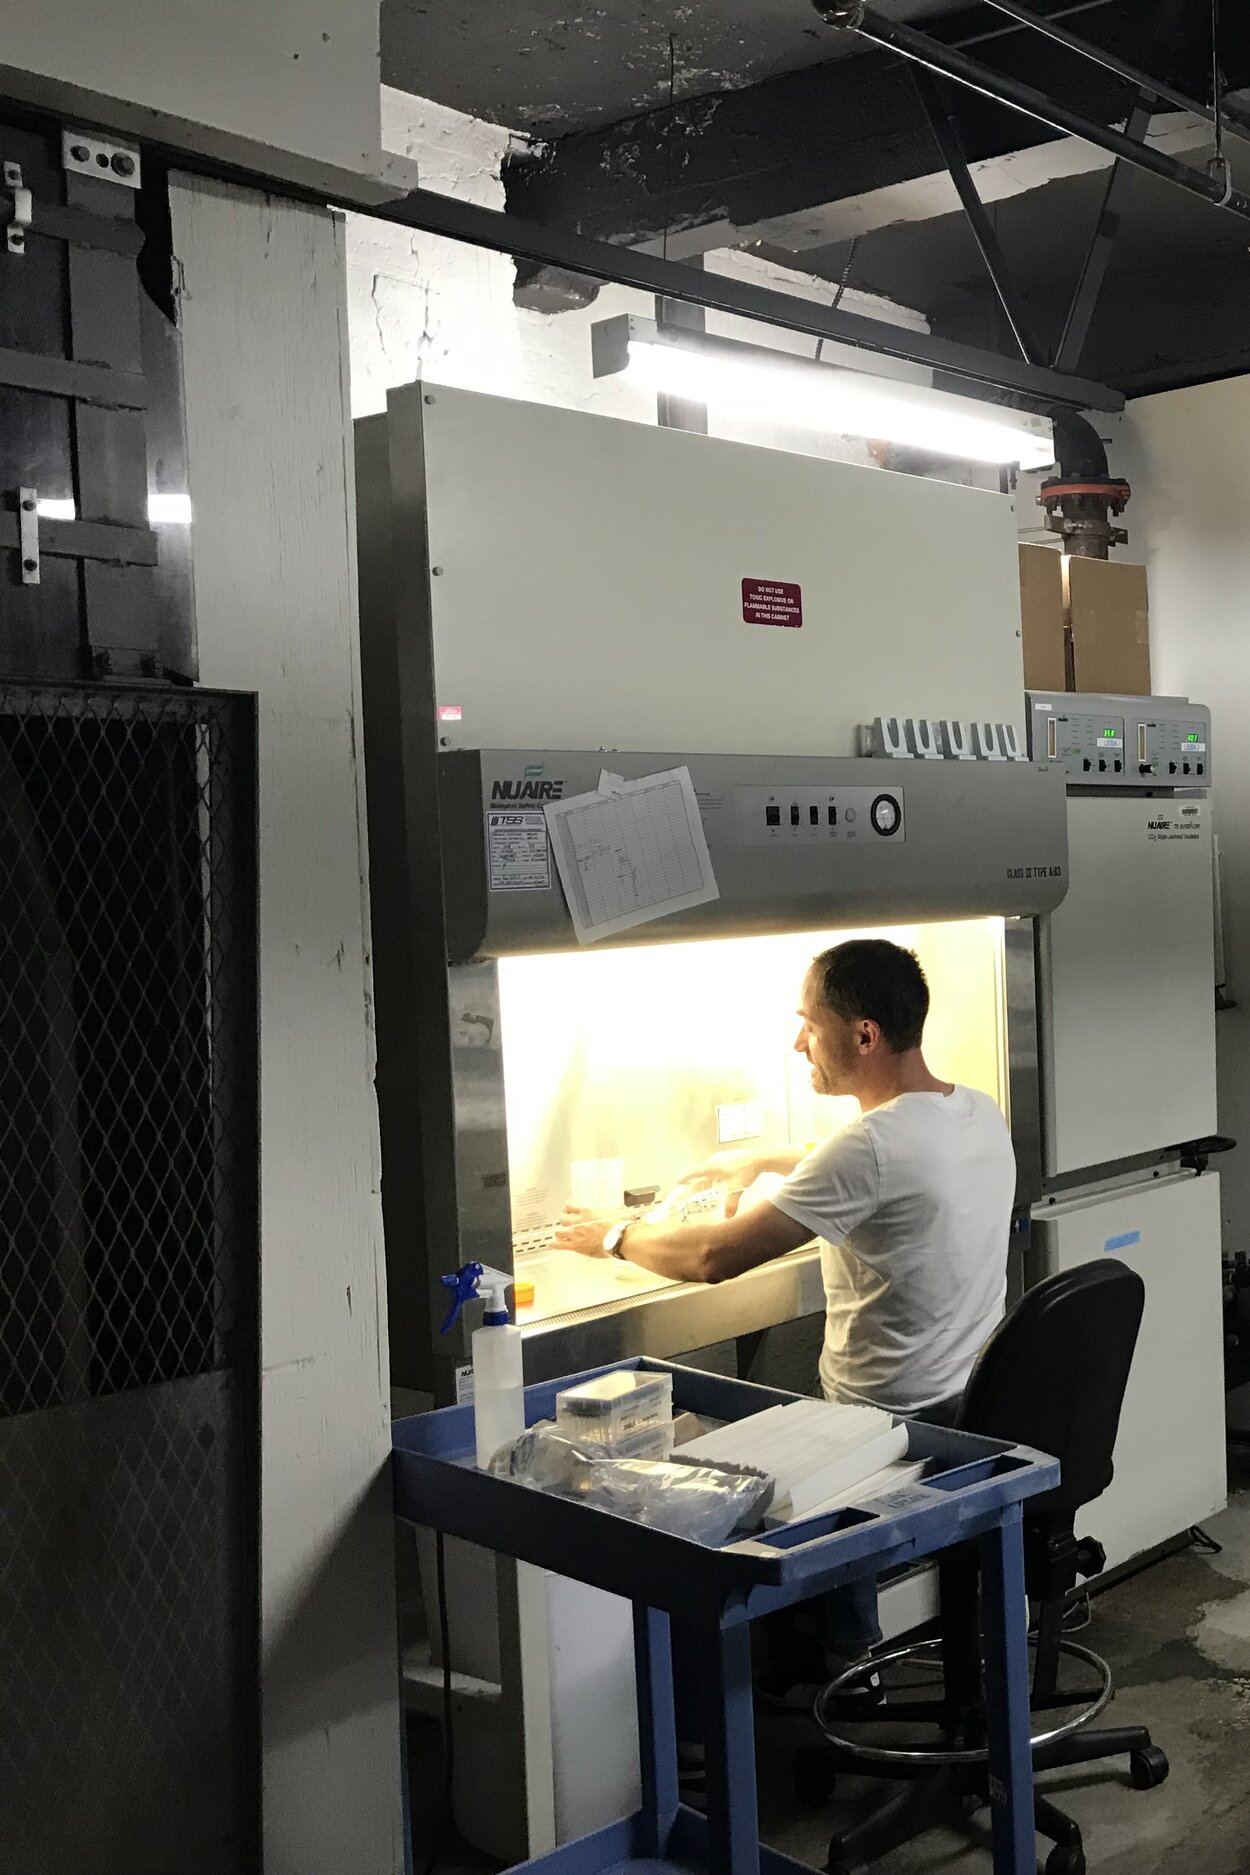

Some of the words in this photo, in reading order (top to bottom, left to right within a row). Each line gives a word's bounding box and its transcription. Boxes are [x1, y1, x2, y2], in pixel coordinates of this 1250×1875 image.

[744, 602, 771, 611] FLAMMABLE
[771, 604, 800, 614] SUBSTANCES
[491, 781, 563, 800] NUAIRE
[1147, 821, 1170, 830] NUAIRE
[1033, 866, 1047, 878] TYPE
